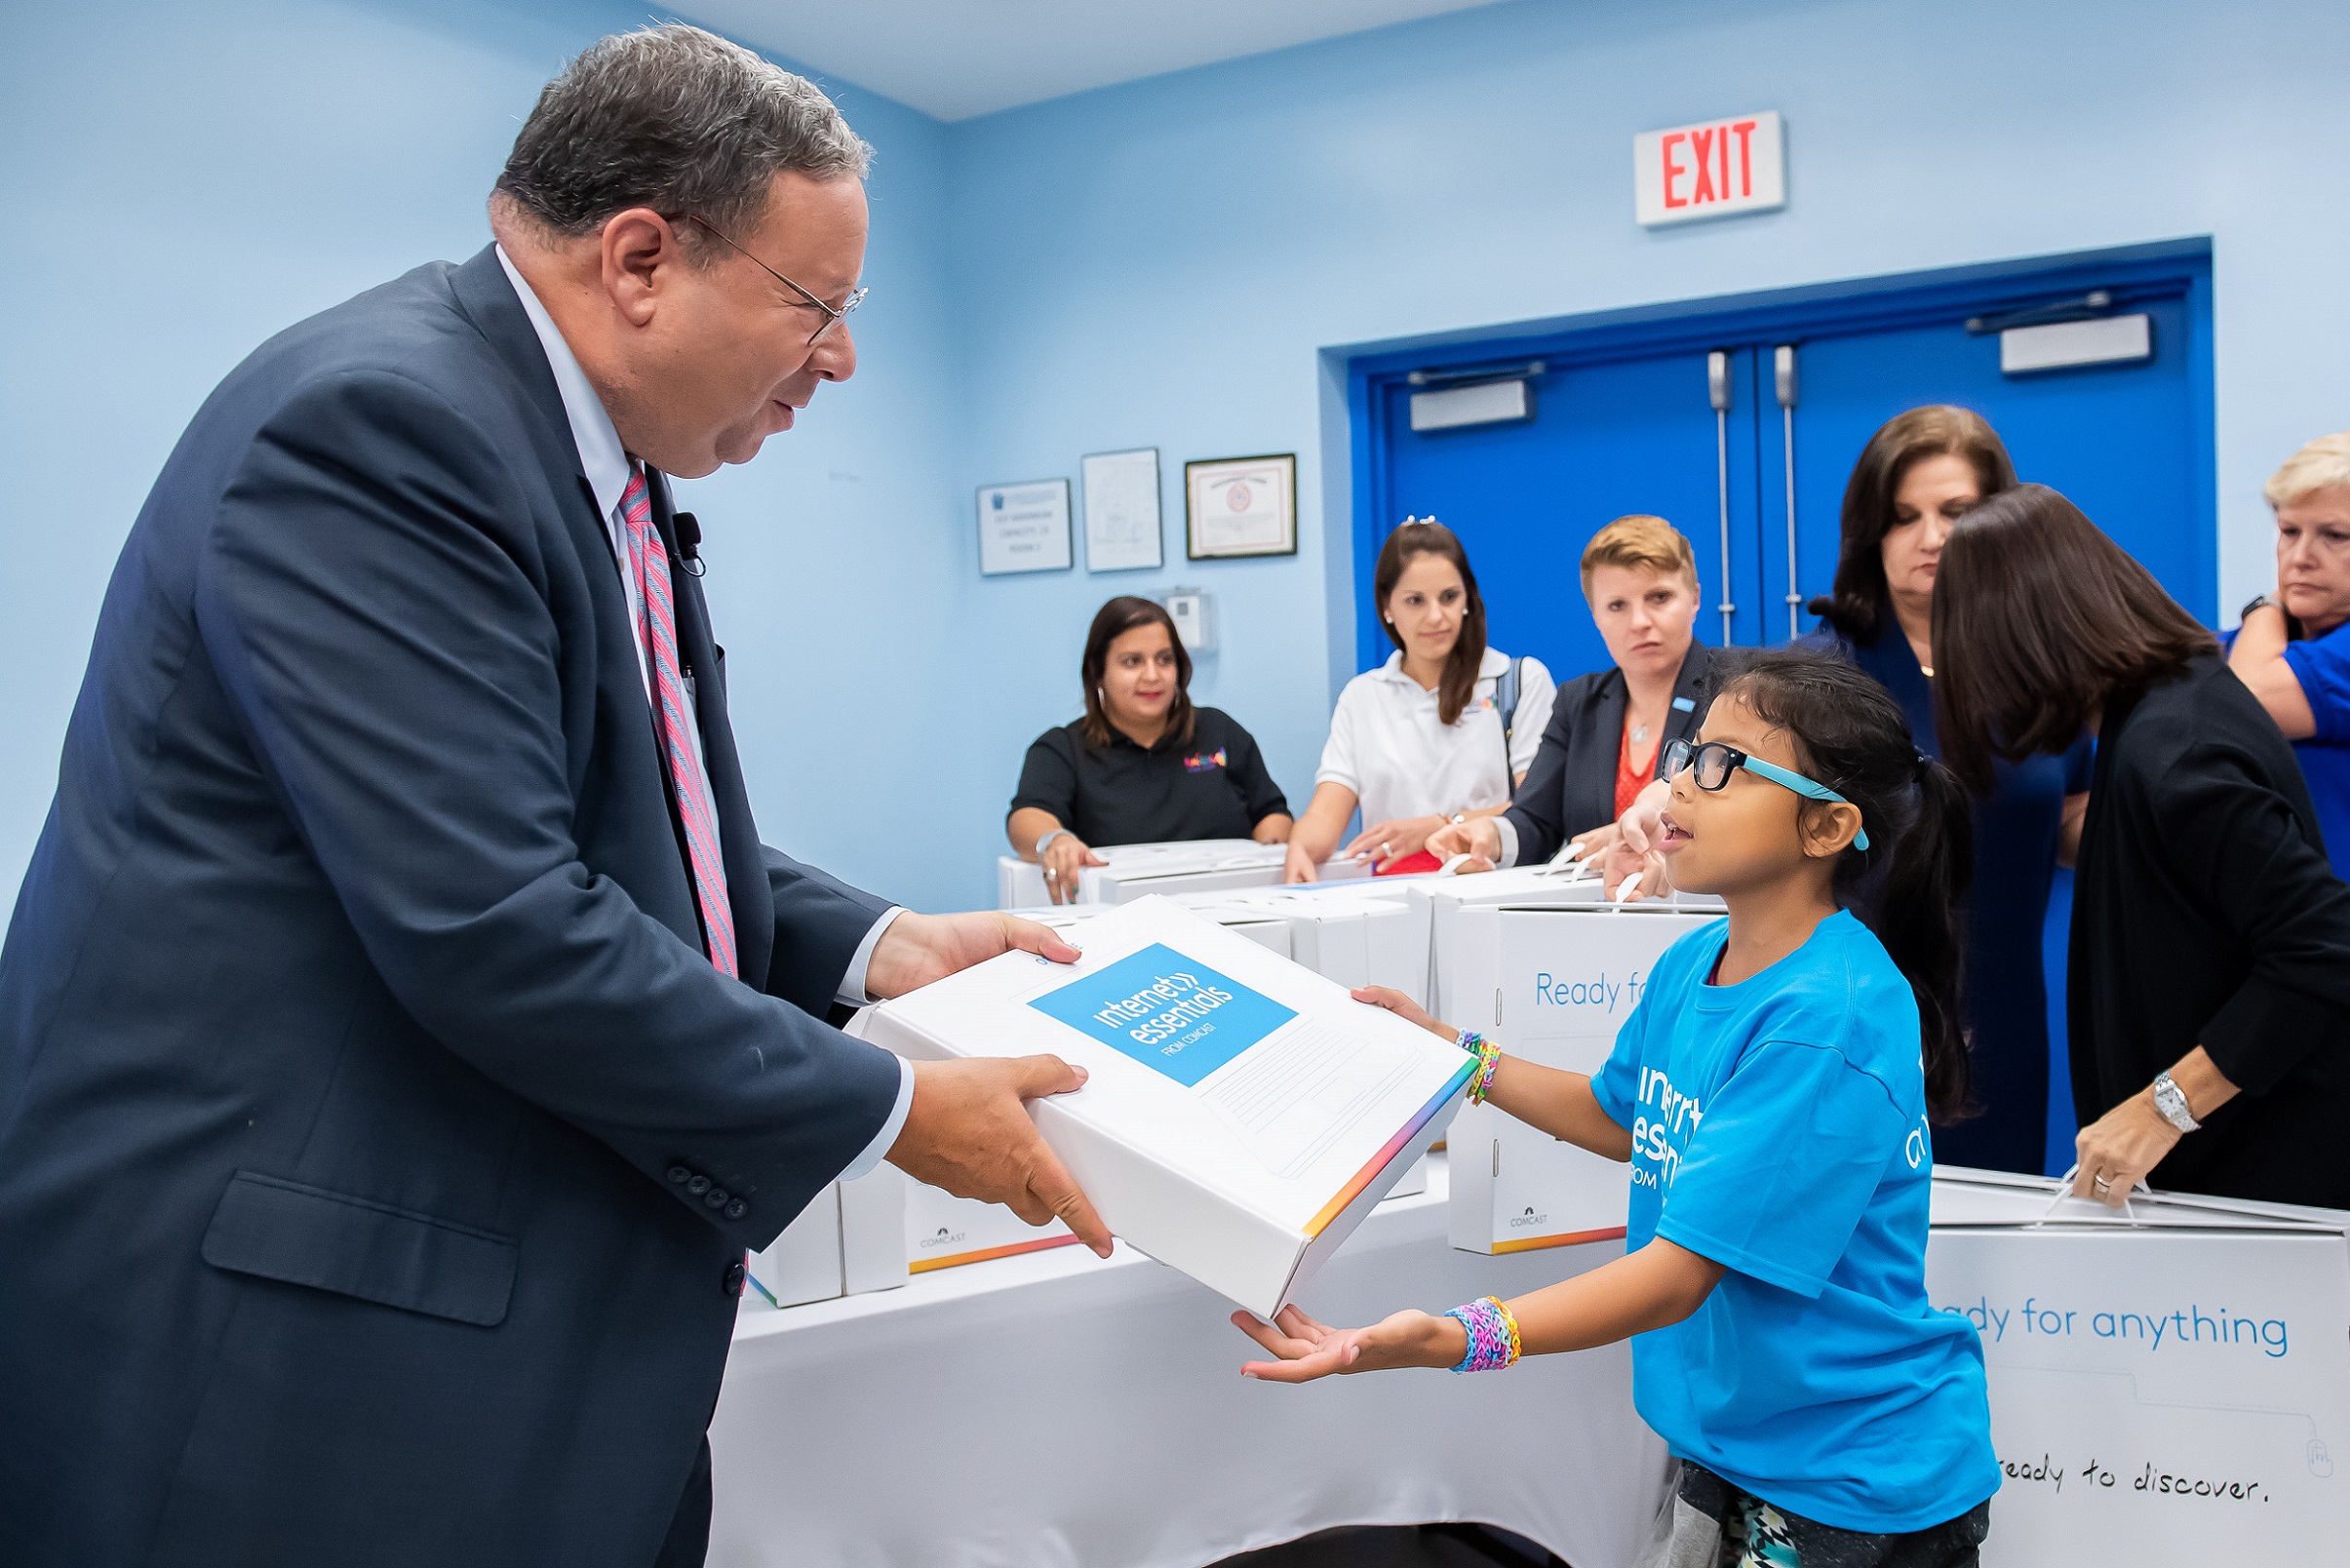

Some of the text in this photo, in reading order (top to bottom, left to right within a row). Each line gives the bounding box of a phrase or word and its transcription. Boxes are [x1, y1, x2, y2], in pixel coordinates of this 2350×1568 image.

[1663, 121, 1756, 209] EXIT
[1129, 986, 1234, 1045] essentials
[1537, 971, 1621, 1014] Ready
[1160, 1022, 1217, 1057] FROM COMCAST
[920, 1233, 966, 1248] COMCAST
[1510, 1214, 1547, 1228] COMCAST
[2021, 1298, 2077, 1335] for
[2093, 1305, 2289, 1358] anything
[1999, 1452, 2270, 1503] eady to discover.
